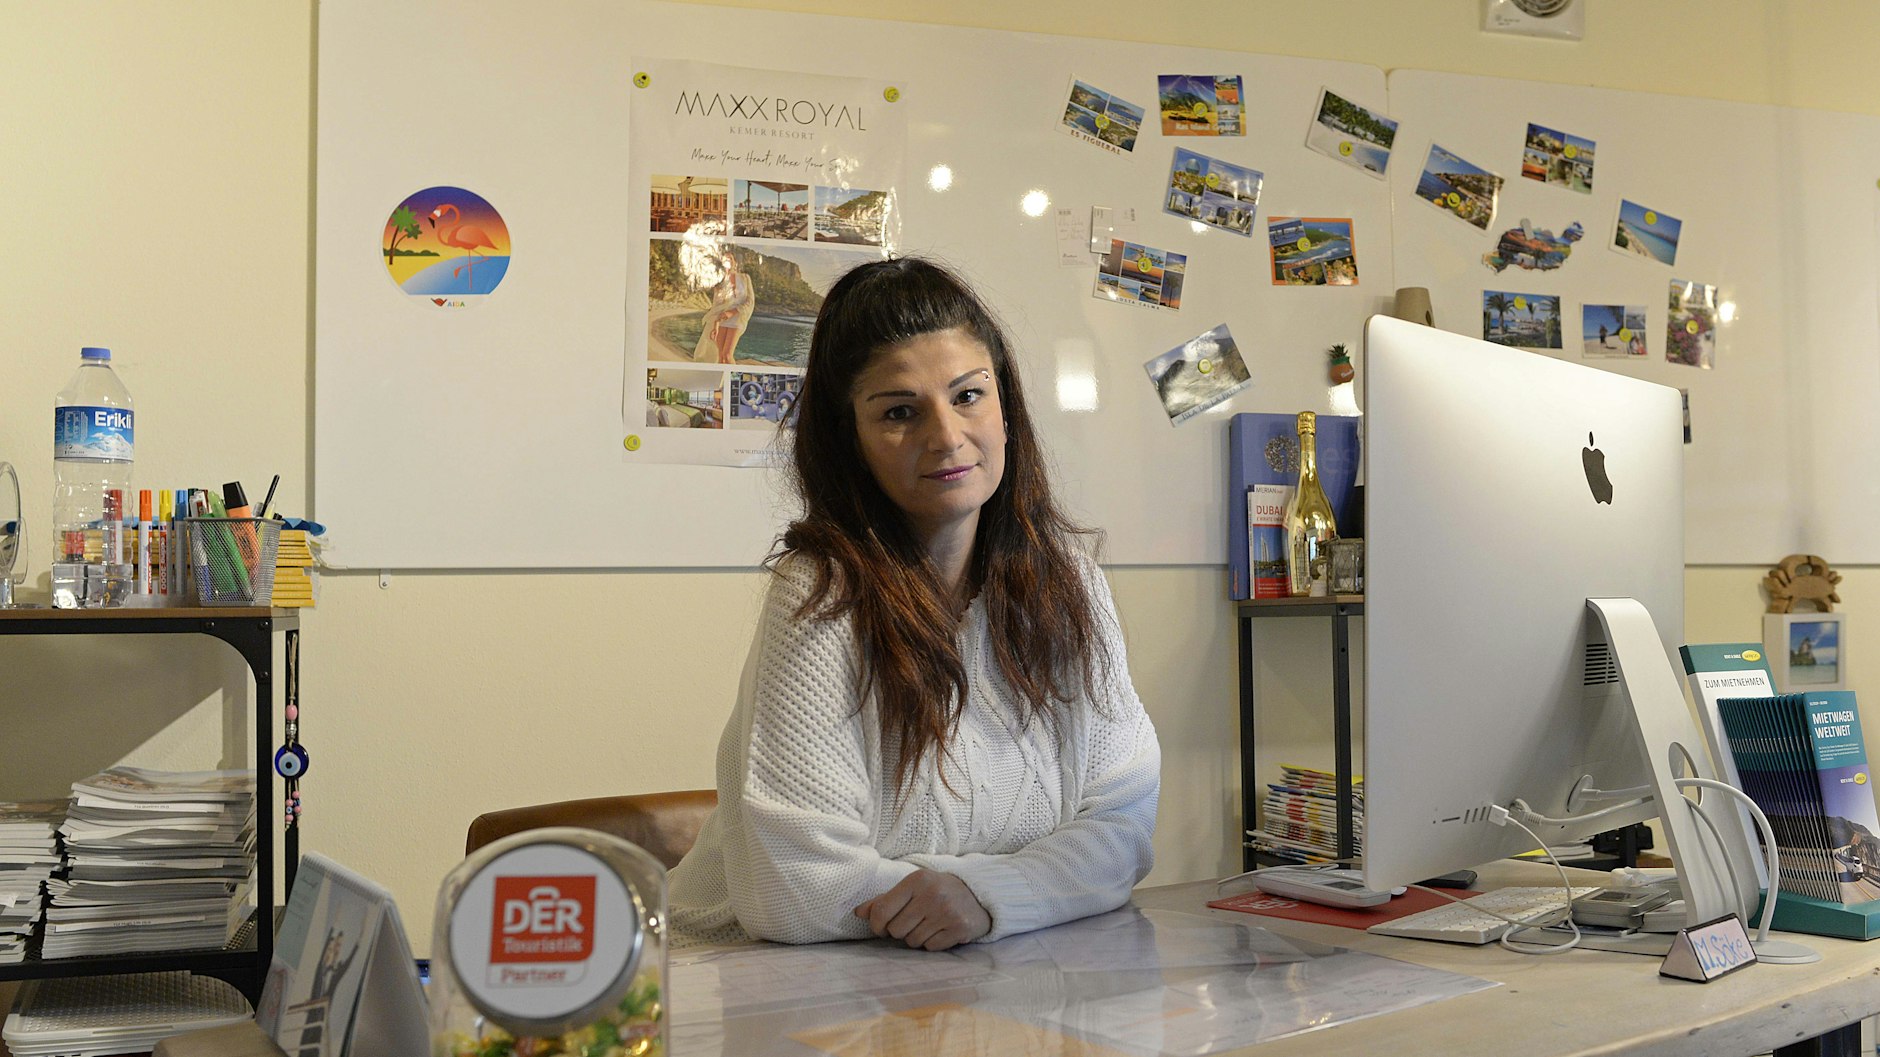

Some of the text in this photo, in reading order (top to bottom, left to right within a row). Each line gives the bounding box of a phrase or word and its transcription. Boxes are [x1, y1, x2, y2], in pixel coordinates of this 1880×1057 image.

[675, 90, 867, 131] MAXX ROYAL
[729, 126, 815, 141] KEMER RESORT
[721, 149, 741, 166] Your
[804, 156, 825, 173] Your
[94, 411, 132, 429] Erikli
[1256, 505, 1283, 516] DUBAI
[1704, 677, 1765, 689] ZUM MIETNEHMEN
[1812, 710, 1855, 725] MIETWAGEN
[1814, 725, 1851, 739] WELTWEIT
[502, 898, 585, 934] DER
[503, 937, 583, 954] Touristik
[501, 968, 566, 983] Partner
